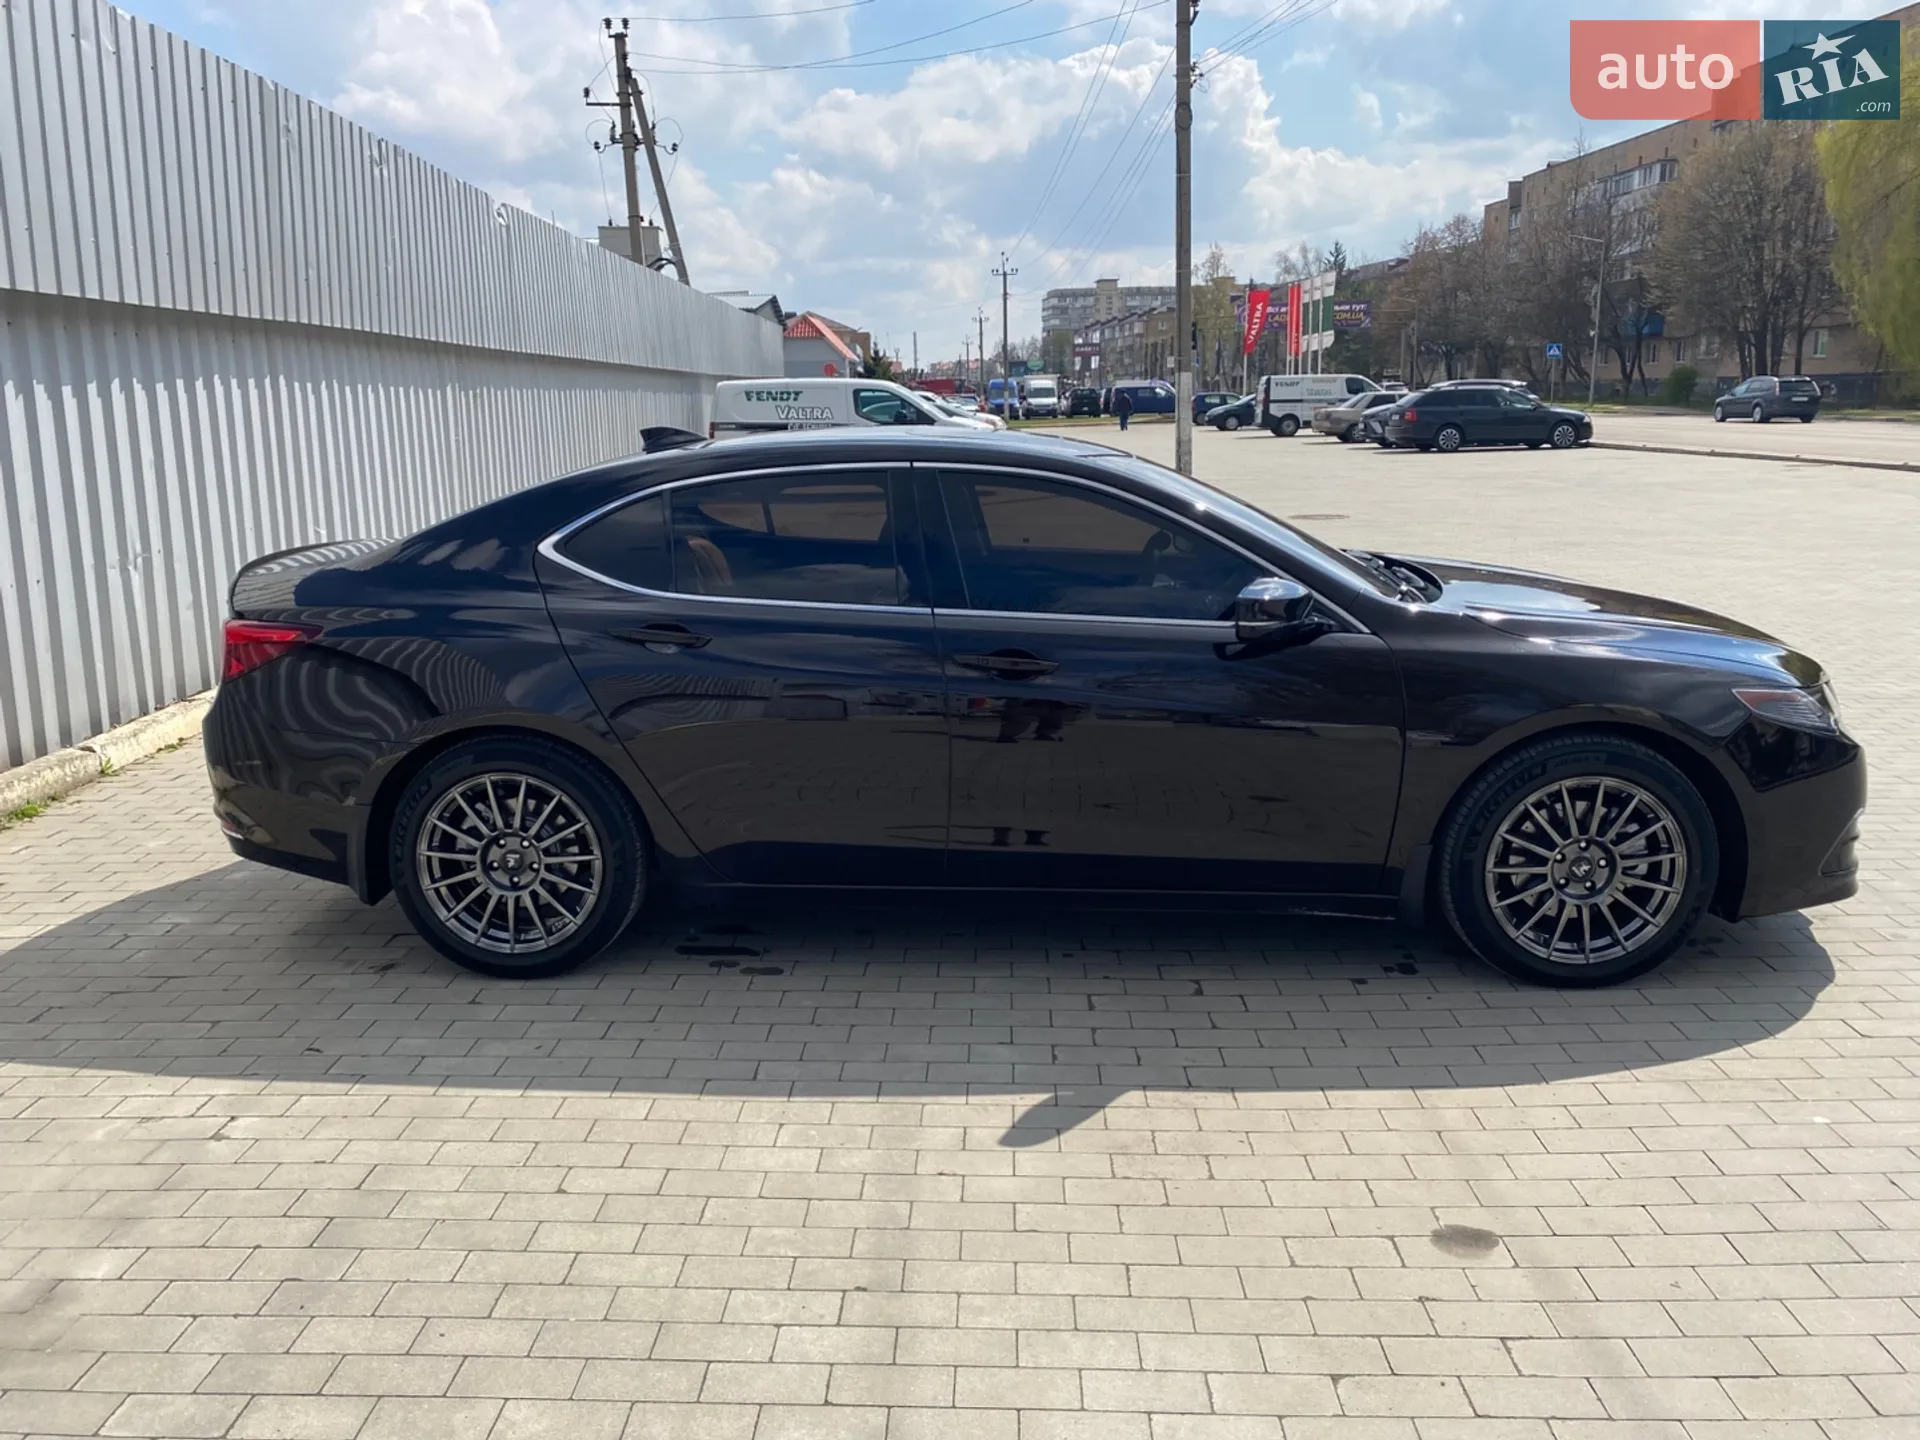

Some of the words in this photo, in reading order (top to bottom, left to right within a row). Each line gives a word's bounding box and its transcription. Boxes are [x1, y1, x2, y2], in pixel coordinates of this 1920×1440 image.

[1247, 302, 1264, 344] VALTRA
[744, 390, 803, 402] FENDT
[776, 405, 834, 420] VALTRA
